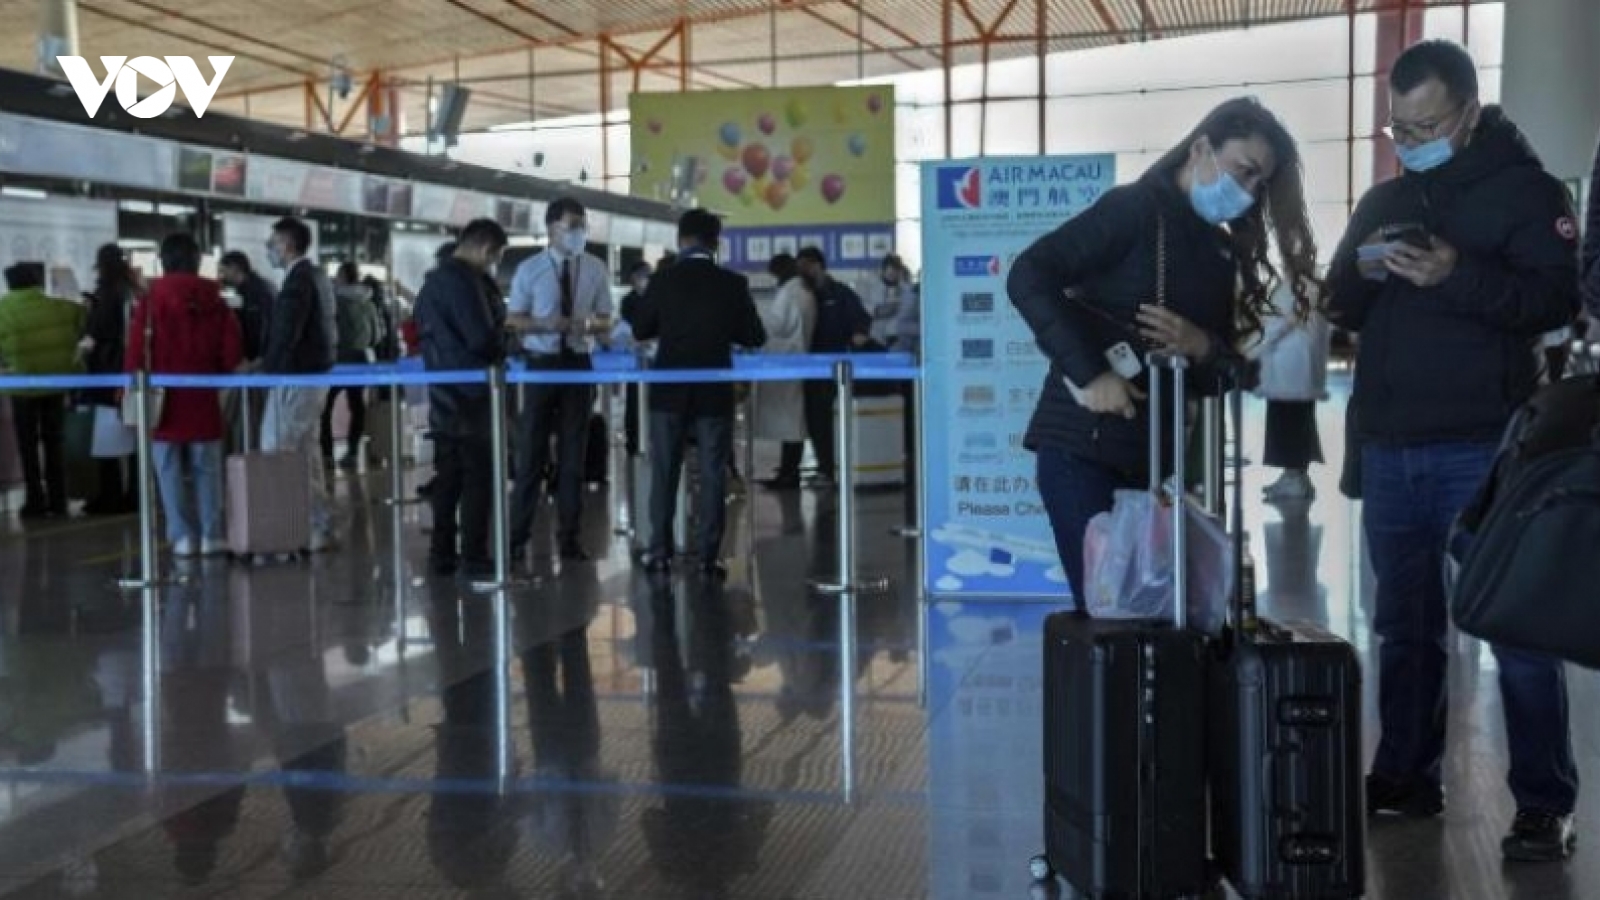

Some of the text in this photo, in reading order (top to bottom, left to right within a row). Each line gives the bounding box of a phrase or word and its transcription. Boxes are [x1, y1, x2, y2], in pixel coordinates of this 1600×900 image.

[988, 162, 1101, 184] AIR MACAU
[954, 475, 1038, 493] 请在此办
[957, 501, 1046, 517] Please Che
